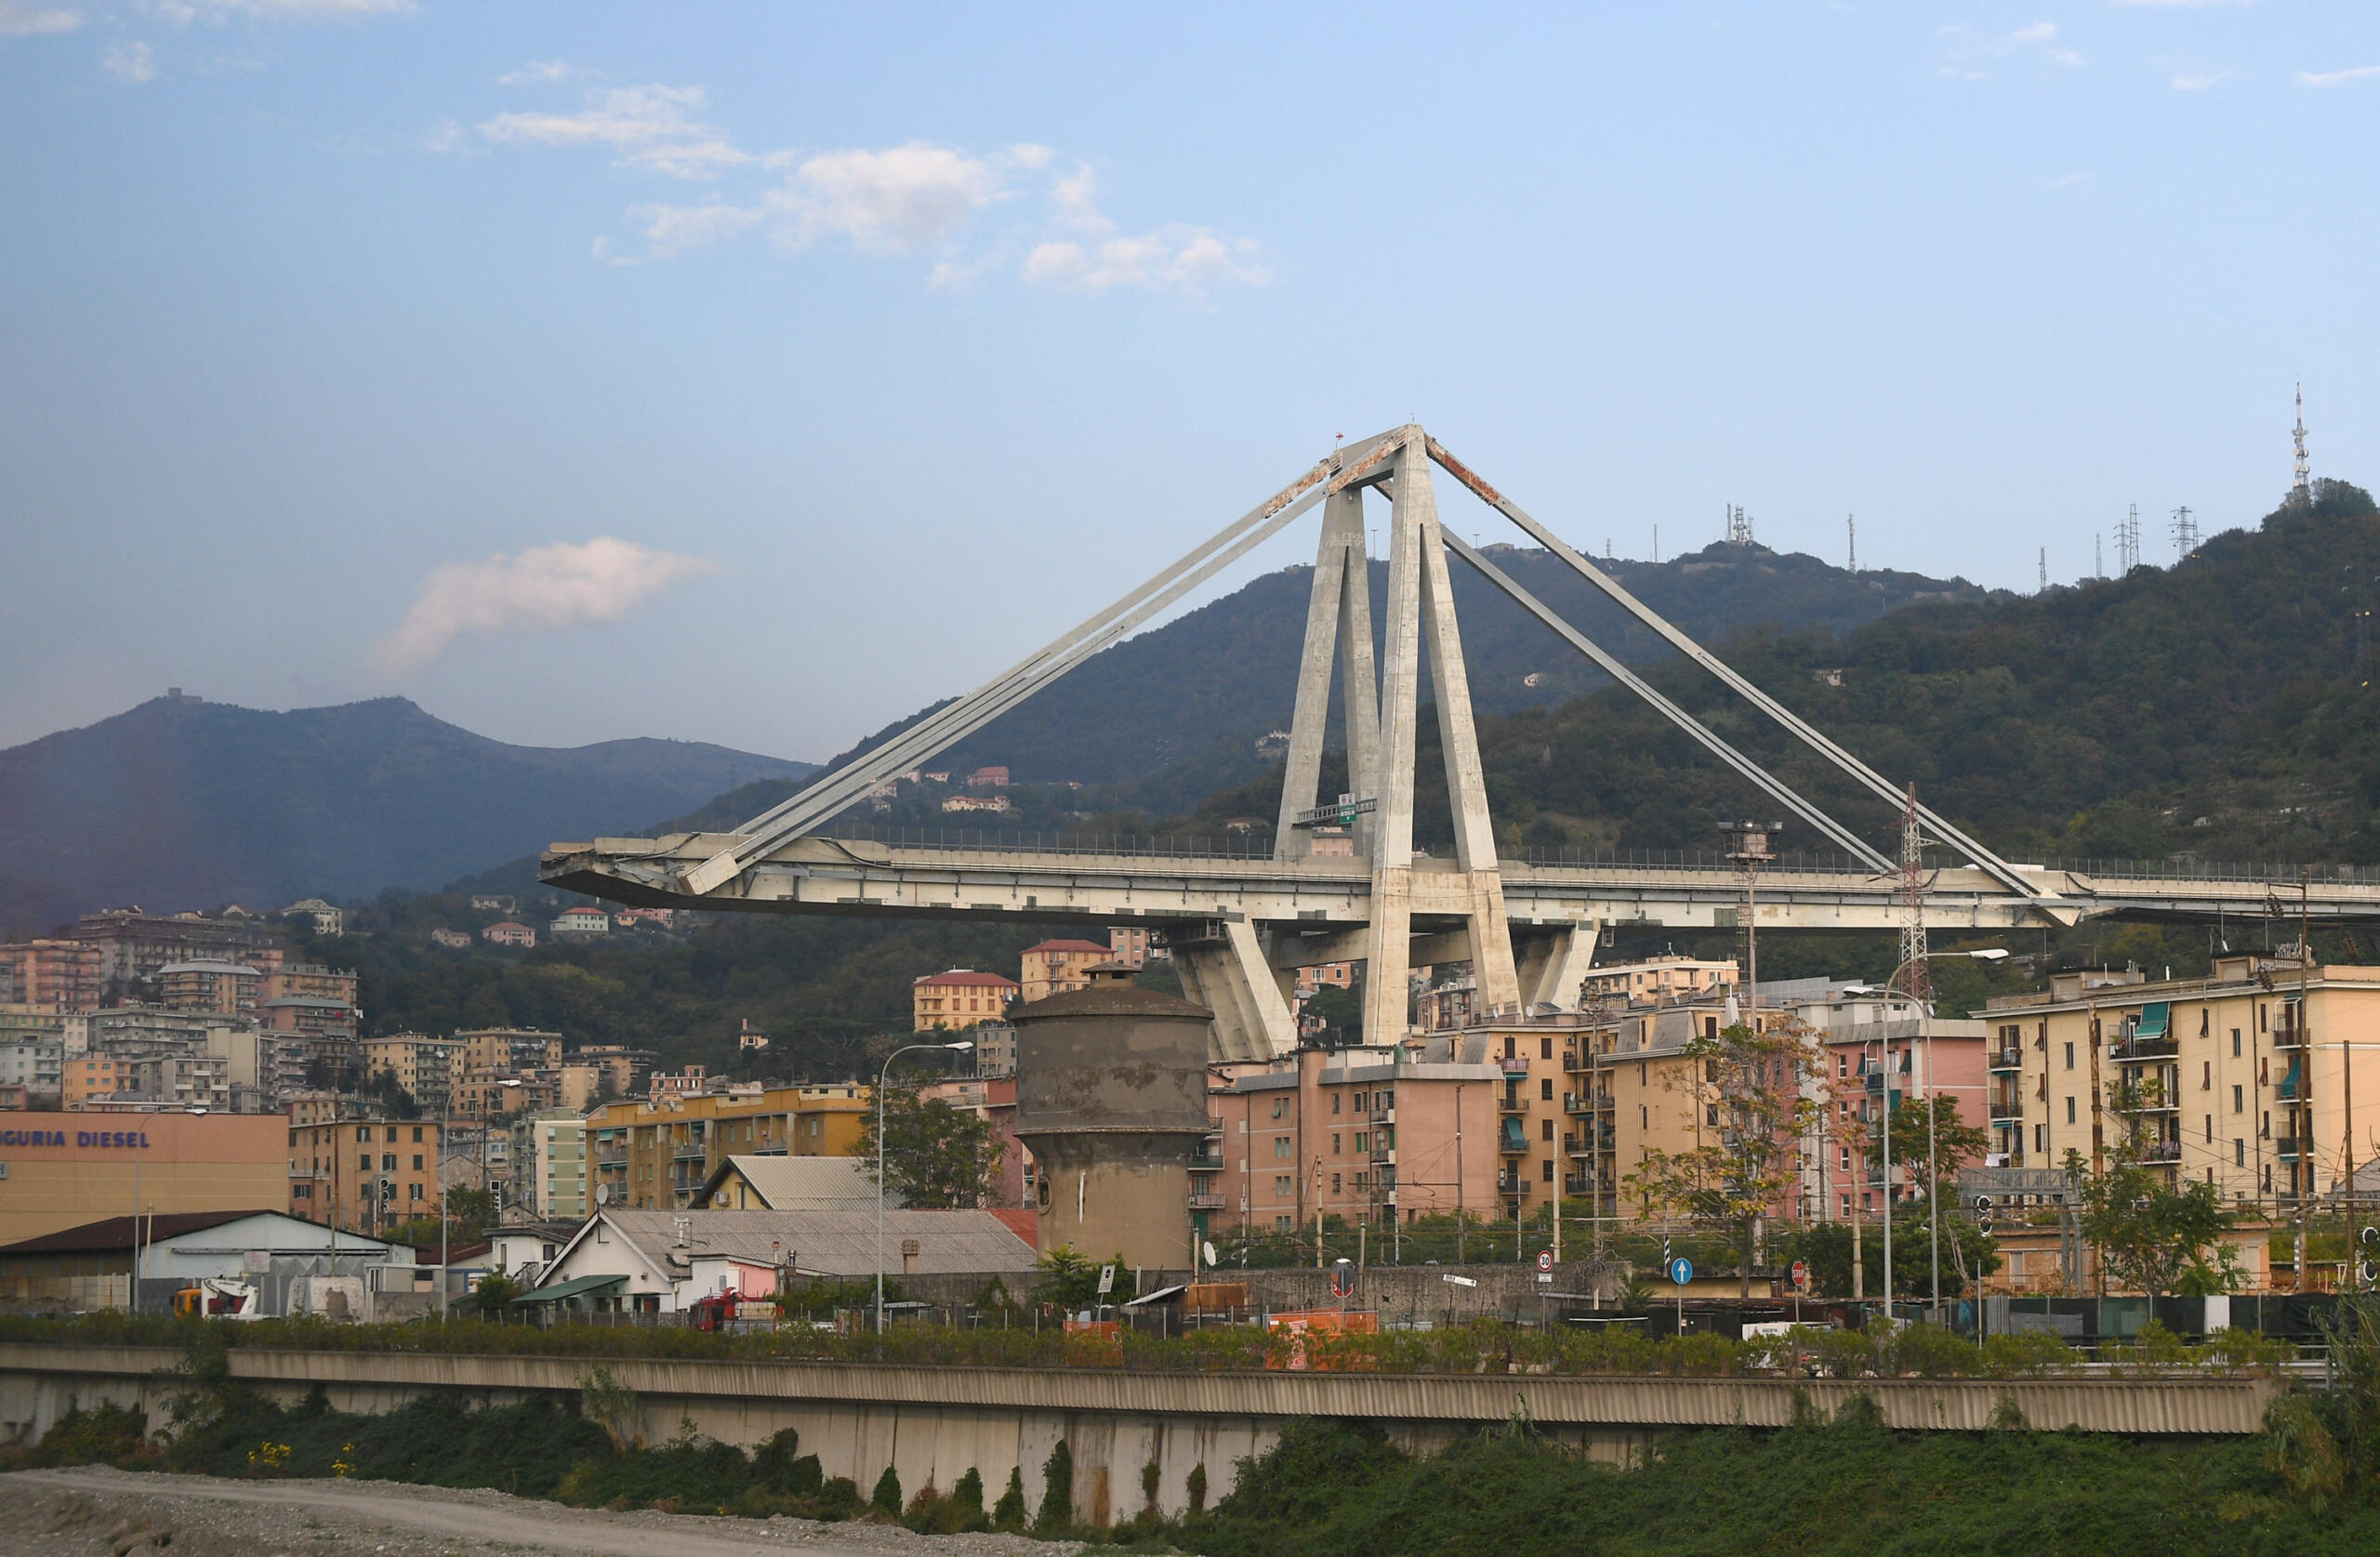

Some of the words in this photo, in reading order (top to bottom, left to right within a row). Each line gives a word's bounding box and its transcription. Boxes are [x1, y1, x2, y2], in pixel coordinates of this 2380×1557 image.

[77, 1130, 150, 1147] DIESEL
[1541, 1256, 1549, 1265] 30
[1792, 1269, 1804, 1278] STOP
